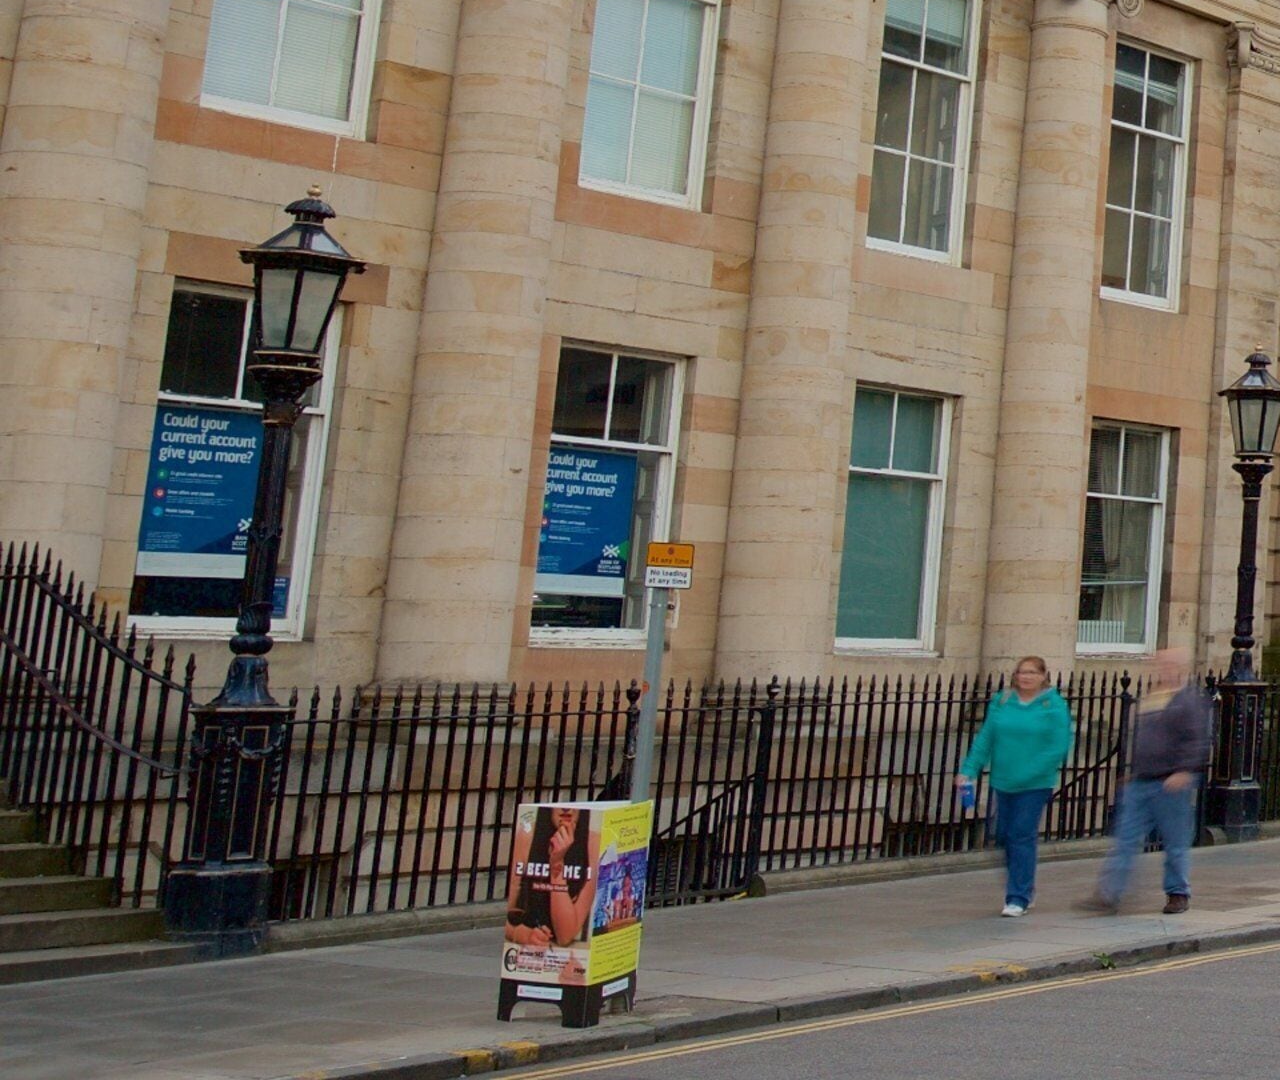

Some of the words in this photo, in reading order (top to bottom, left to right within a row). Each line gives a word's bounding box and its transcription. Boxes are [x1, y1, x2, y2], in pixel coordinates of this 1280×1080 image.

[163, 412, 199, 429] Could
[200, 419, 230, 432] your
[161, 431, 207, 445] current
[208, 434, 257, 449] account
[158, 445, 186, 462] give
[188, 448, 212, 464] you
[214, 451, 254, 464] more?
[549, 452, 574, 466] Could
[575, 457, 598, 469] your
[547, 468, 580, 480] current
[581, 472, 618, 484] account
[545, 481, 564, 495] give
[566, 484, 584, 497] you
[585, 485, 616, 498] more?
[662, 569, 688, 578] loading
[516, 861, 524, 875] 2
[587, 866, 592, 880] 1
